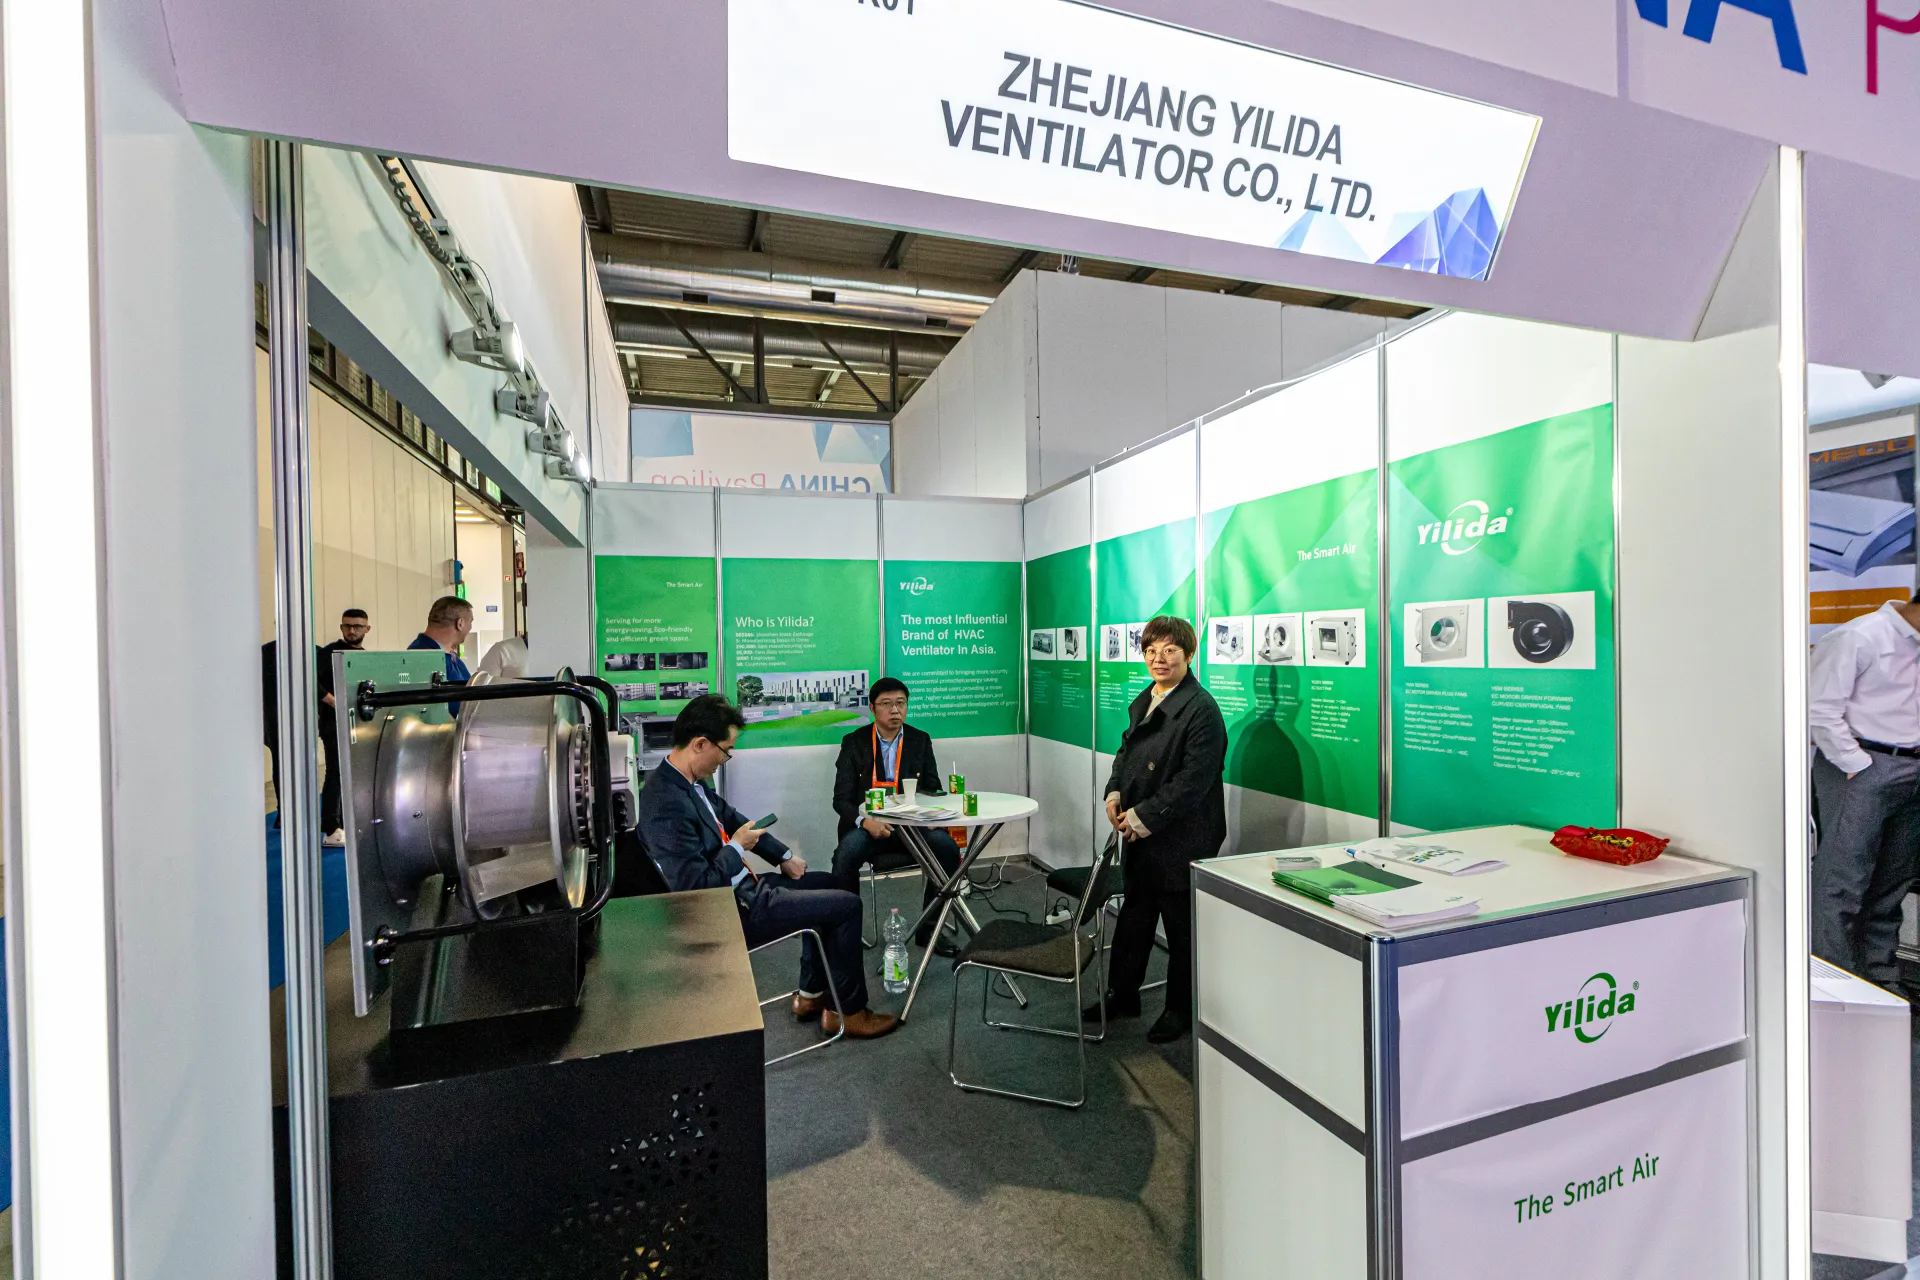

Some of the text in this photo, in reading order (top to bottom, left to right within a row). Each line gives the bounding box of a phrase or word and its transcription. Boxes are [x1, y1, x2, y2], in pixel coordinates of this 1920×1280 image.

[998, 51, 1341, 165] ZHEJIANG YILIDA
[941, 99, 1375, 221] VENTILATOR CO., LTD.
[1417, 511, 1509, 546] Yilida
[1297, 543, 1356, 561] The Smart Air
[900, 580, 934, 592] Yilida
[735, 616, 815, 627] Who is Yilida?
[901, 614, 1008, 625] The most Influential
[902, 629, 985, 640] Brand of HVAC
[902, 644, 996, 656] Ventilator In Asia.
[955, 669, 976, 677] bringing
[914, 711, 932, 719] healthy
[1545, 990, 1636, 1033] Yilida
[1514, 1152, 1660, 1224] The Smart Air
